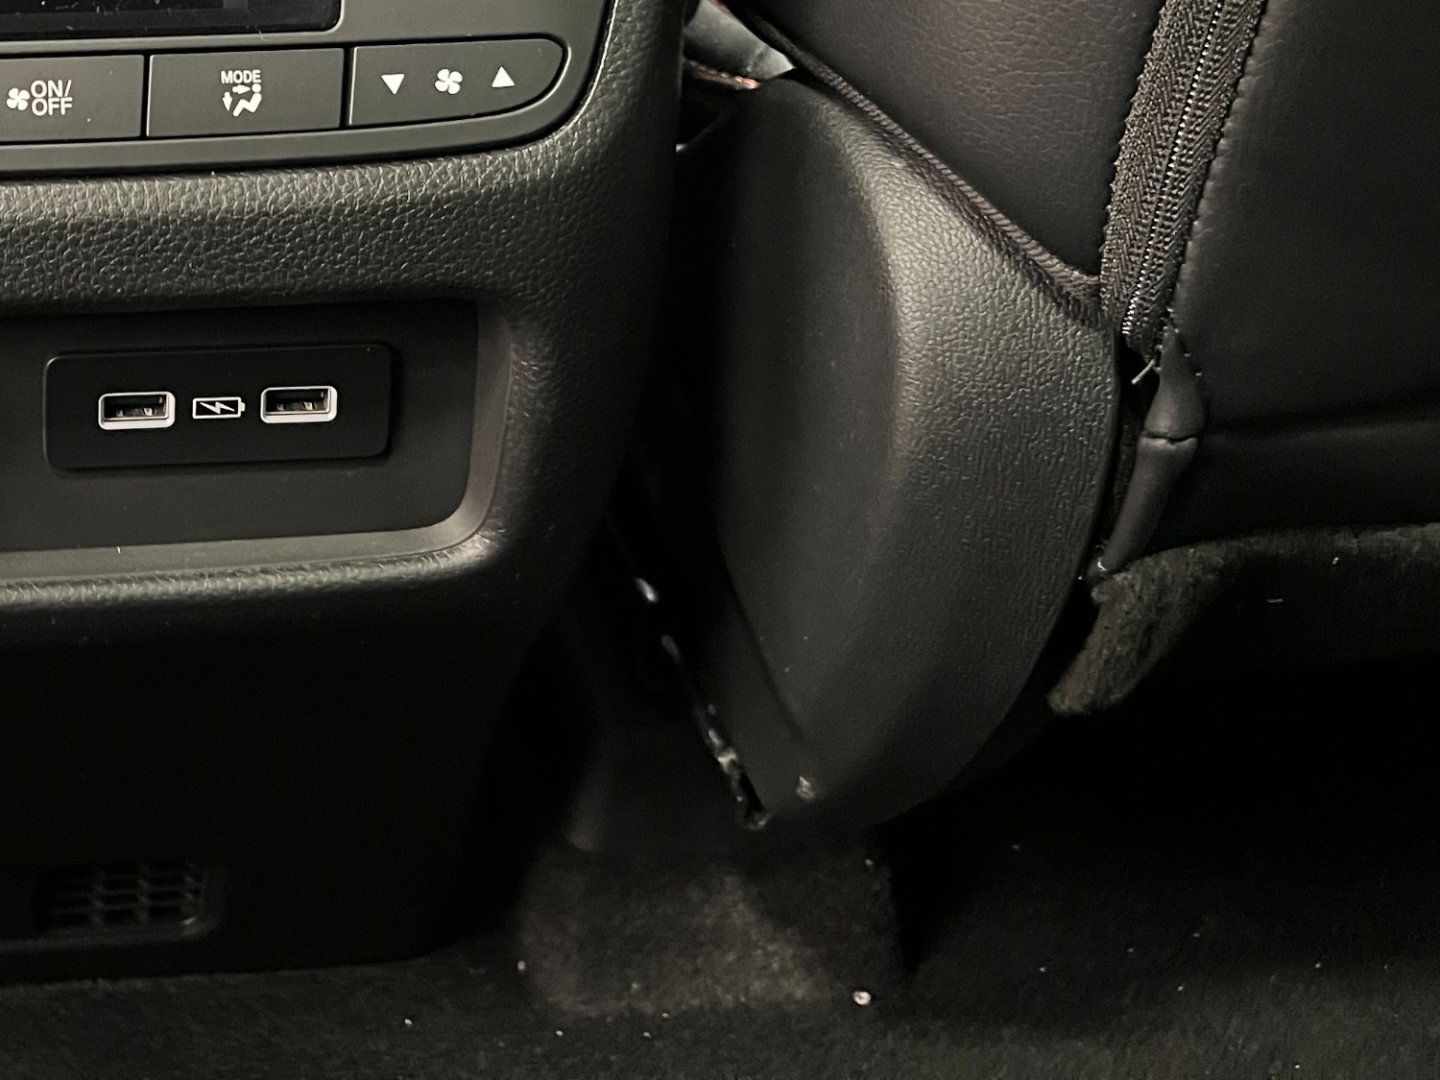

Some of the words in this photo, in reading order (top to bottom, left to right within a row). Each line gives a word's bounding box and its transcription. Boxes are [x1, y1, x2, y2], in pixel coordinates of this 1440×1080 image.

[220, 69, 262, 84] MODE
[31, 80, 72, 99] ON/
[31, 97, 73, 117] OFF
